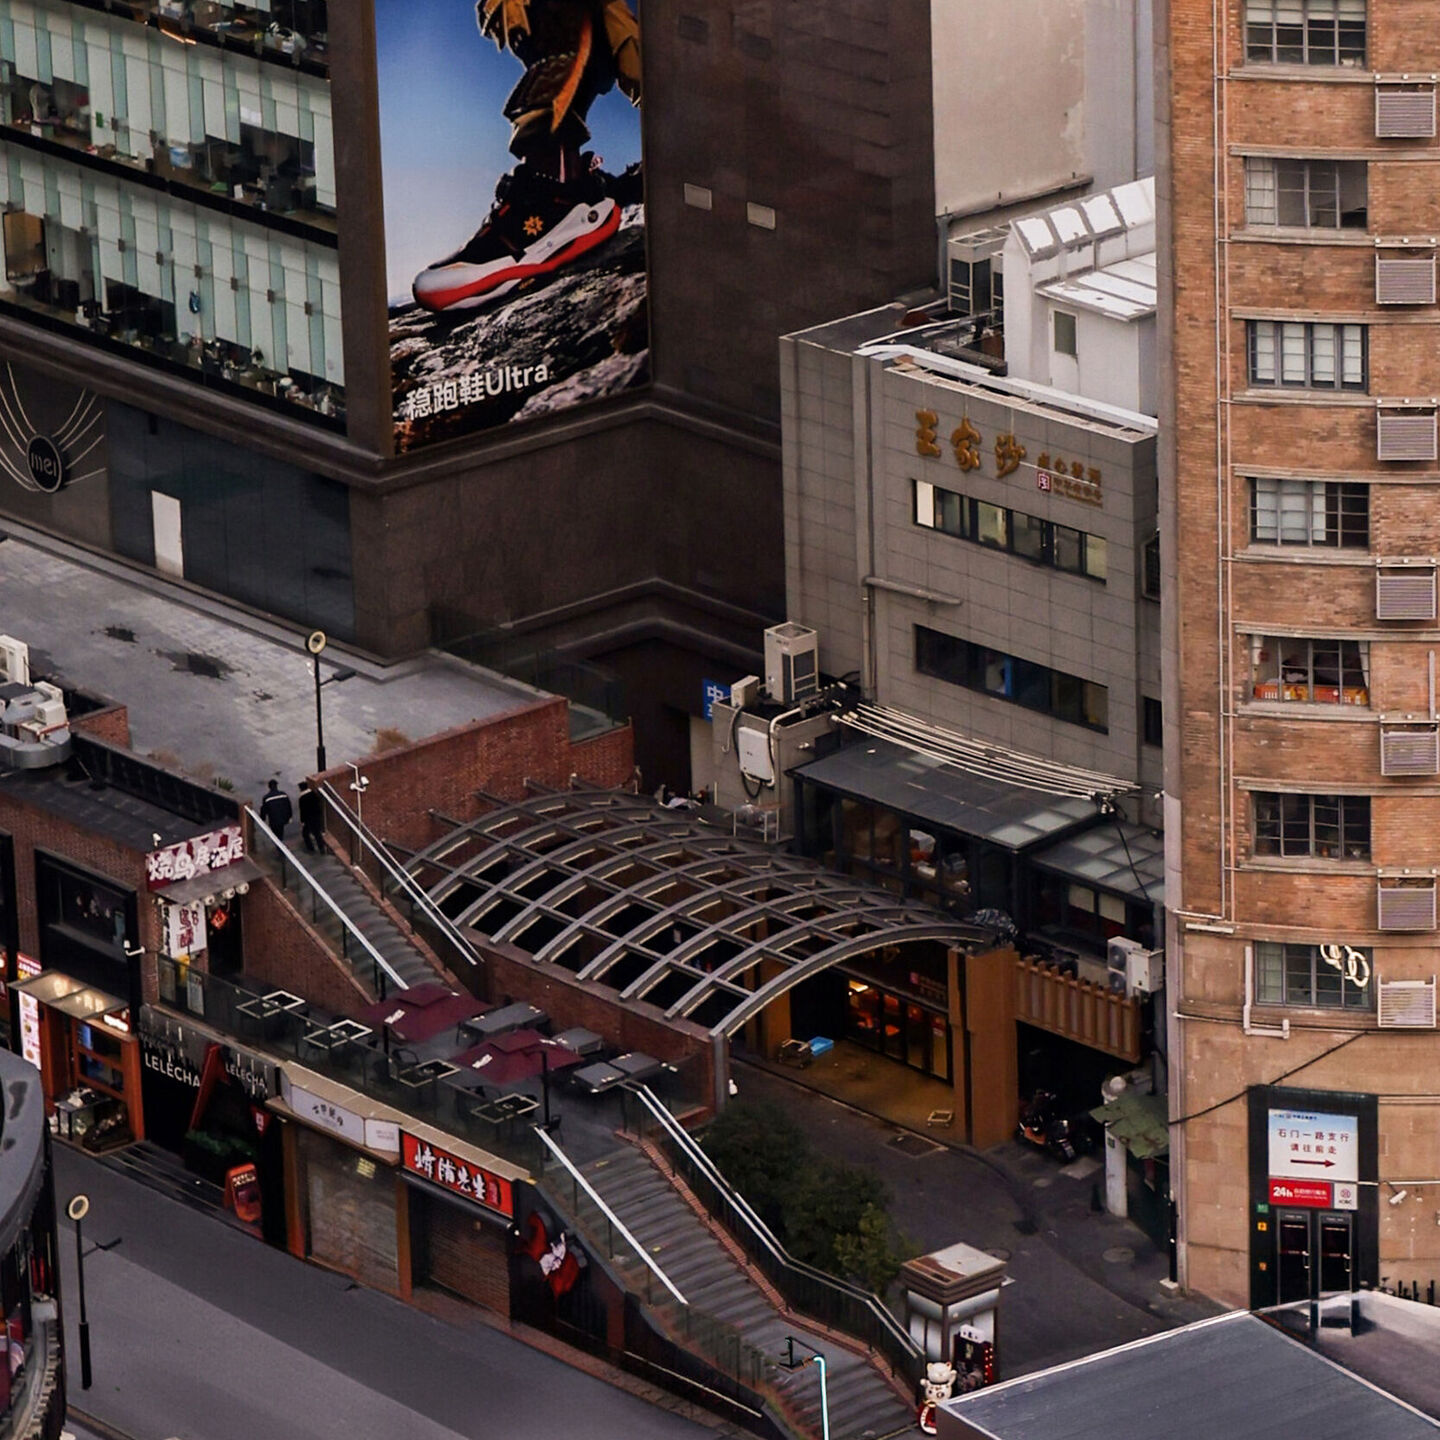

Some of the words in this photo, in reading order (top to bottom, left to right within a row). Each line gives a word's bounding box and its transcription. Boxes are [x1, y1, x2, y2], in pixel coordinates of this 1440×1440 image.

[404, 363, 549, 421] 稳跑鞋Ultra
[916, 408, 1027, 478] 王家沙
[145, 1052, 200, 1087] LELECHA
[225, 1063, 265, 1089] LELECHA
[1278, 1128, 1349, 1142] 石门一路支行
[1273, 1186, 1293, 1198] 24h
